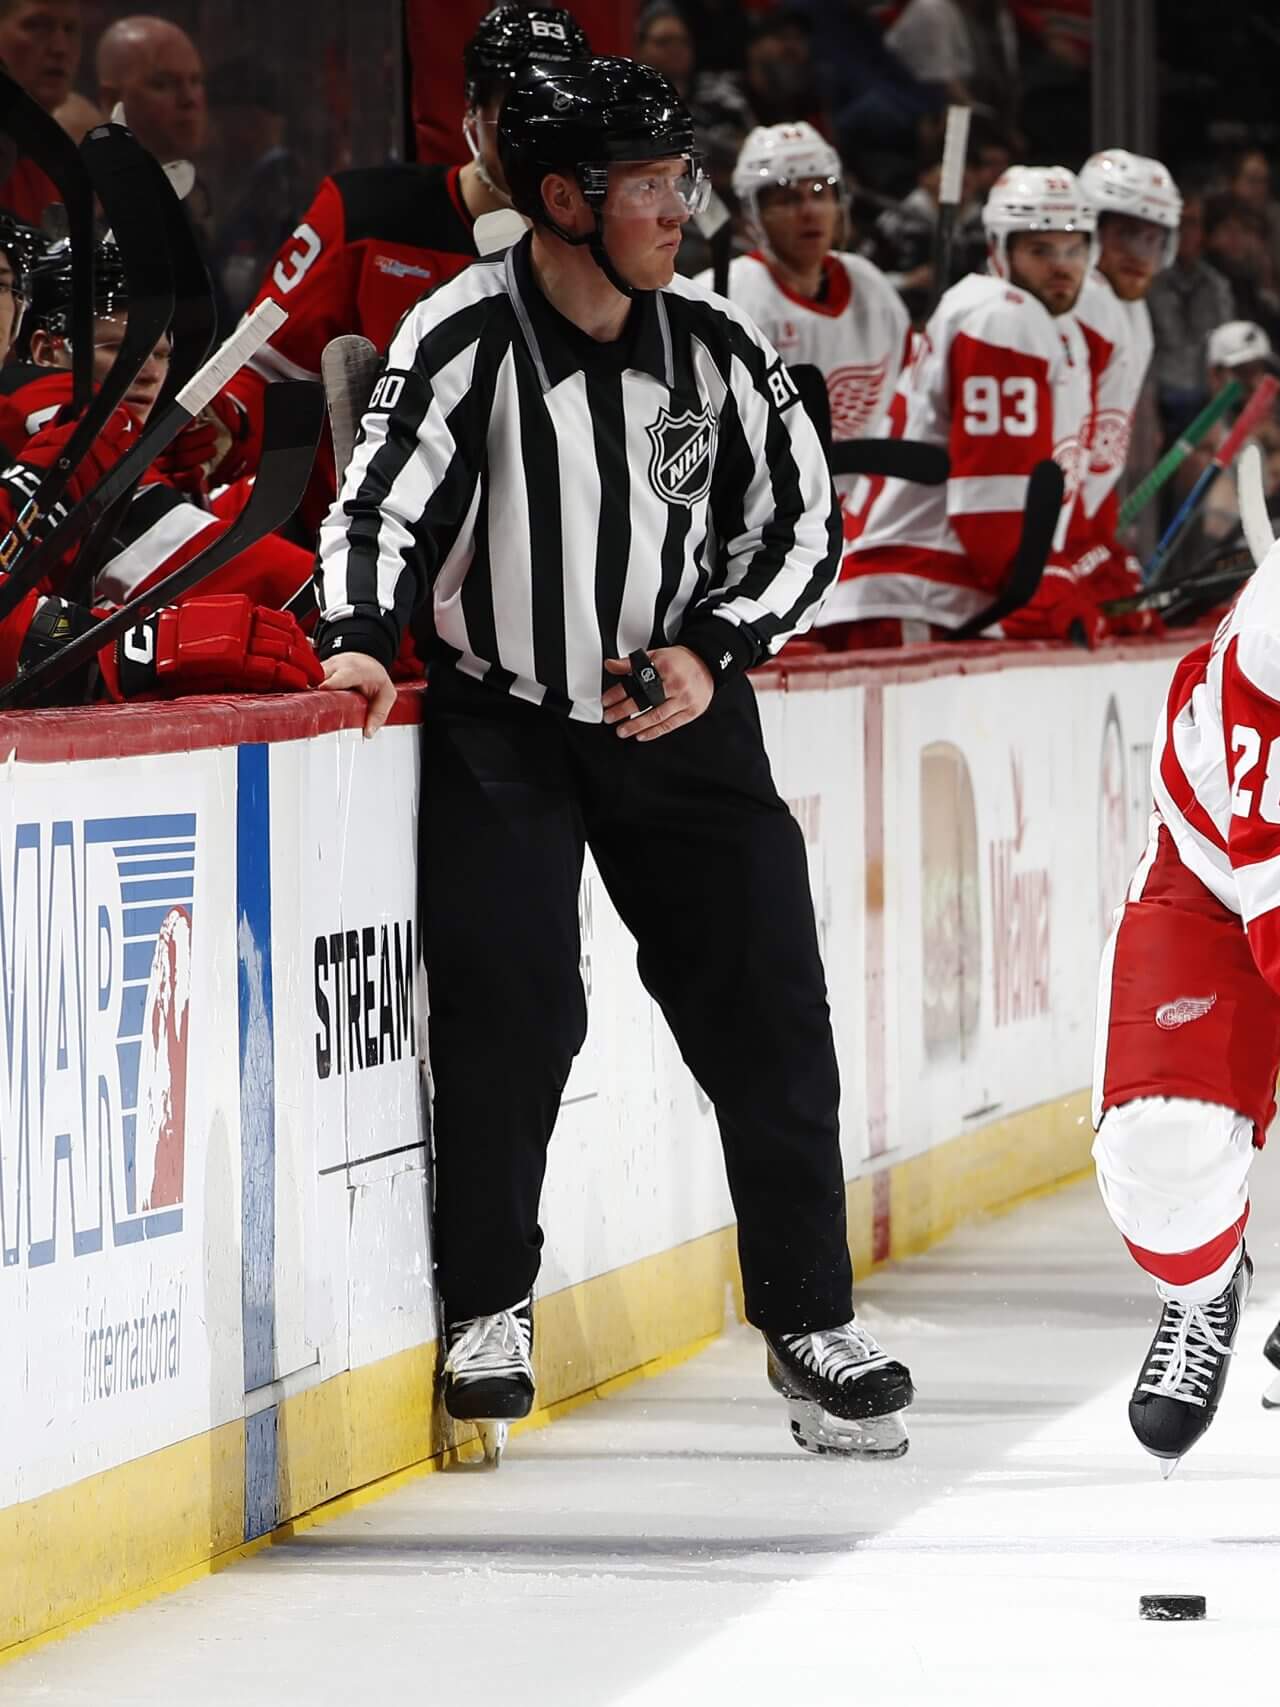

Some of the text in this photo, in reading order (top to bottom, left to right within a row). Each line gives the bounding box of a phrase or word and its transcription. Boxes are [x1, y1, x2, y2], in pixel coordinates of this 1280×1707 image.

[531, 20, 566, 40] 63
[273, 223, 321, 294] 3
[369, 375, 406, 408] 80
[963, 375, 1037, 438] 93
[669, 433, 709, 488] NHL
[314, 919, 416, 1080] STREAM
[82, 1283, 182, 1404] international
